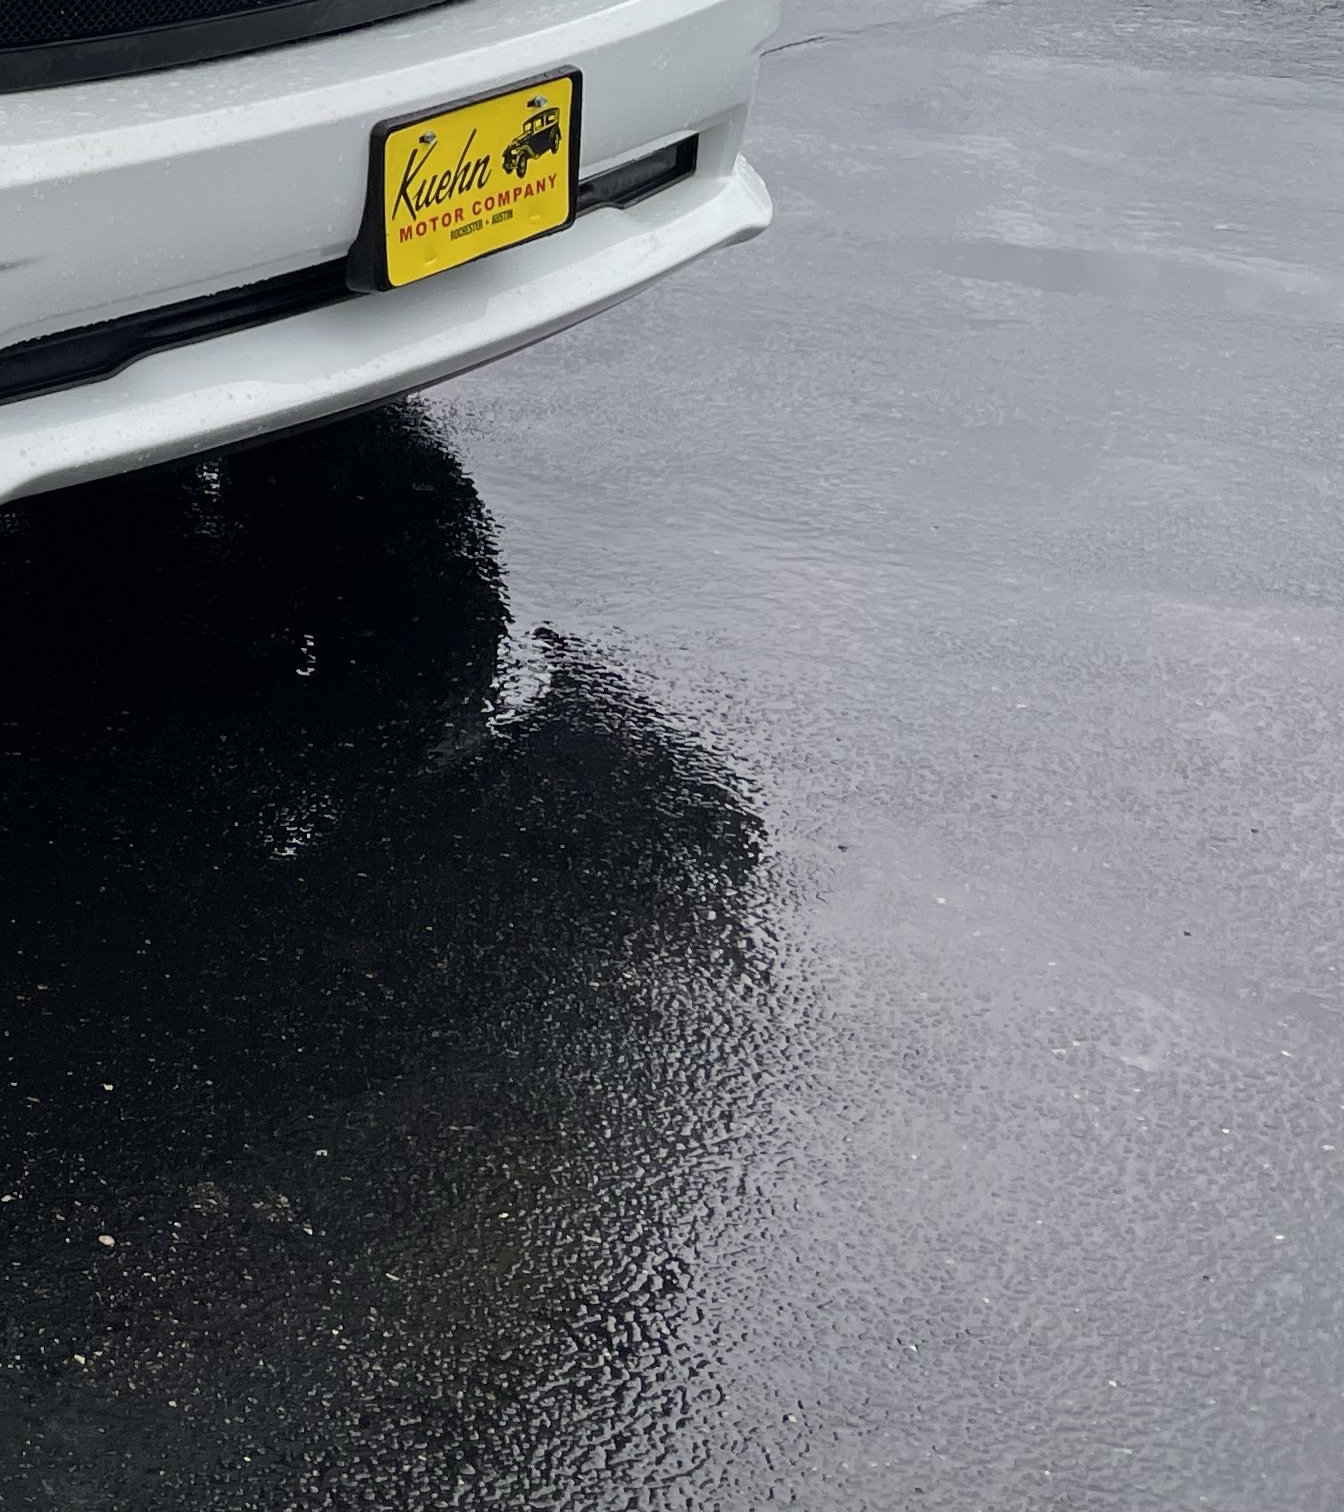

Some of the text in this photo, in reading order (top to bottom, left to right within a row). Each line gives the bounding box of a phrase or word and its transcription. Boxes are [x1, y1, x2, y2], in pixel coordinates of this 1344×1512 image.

[392, 127, 491, 222] Kuehn
[400, 173, 557, 243] MOTOR COMPANY
